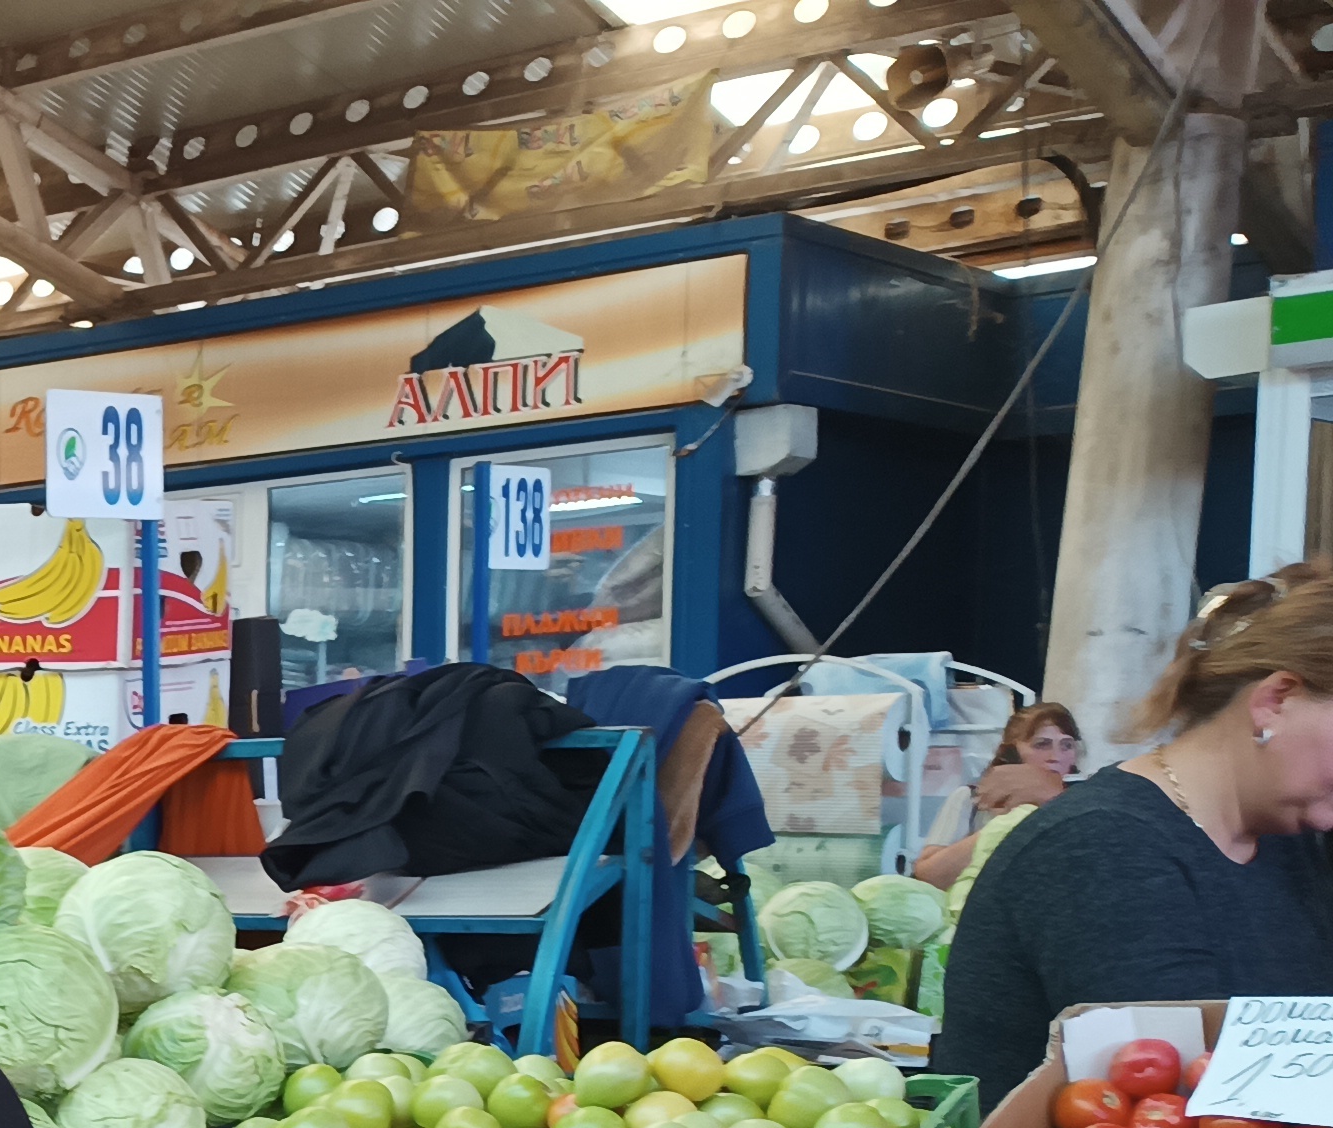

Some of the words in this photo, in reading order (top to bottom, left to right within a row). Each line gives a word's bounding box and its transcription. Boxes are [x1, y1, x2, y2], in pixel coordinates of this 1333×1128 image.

[385, 352, 582, 427] АЛПИ
[101, 405, 144, 506] 38
[502, 478, 544, 558] 138
